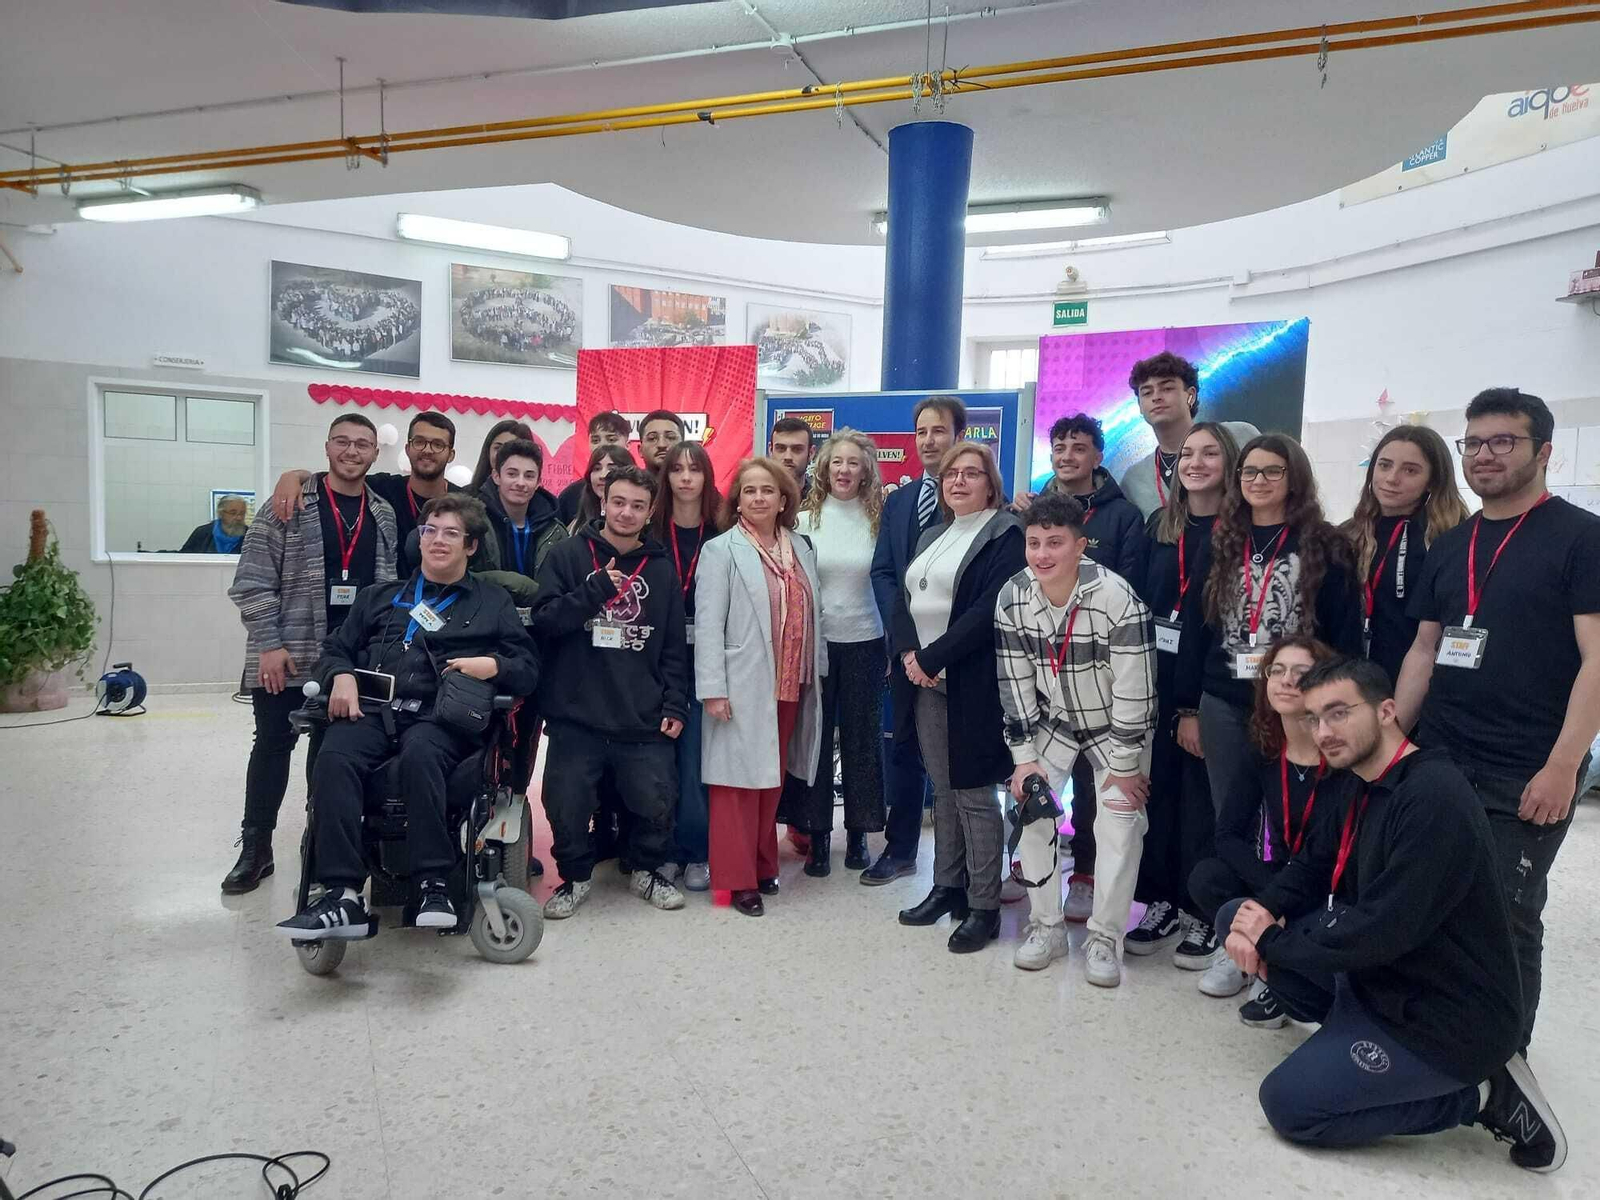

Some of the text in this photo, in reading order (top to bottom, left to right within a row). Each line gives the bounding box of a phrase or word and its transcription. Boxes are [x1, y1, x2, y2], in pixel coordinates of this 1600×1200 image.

[1549, 106, 1559, 118] de
[1409, 151, 1438, 166] COPPER
[1055, 308, 1085, 319] SALIDA
[964, 426, 998, 439] ARLA
